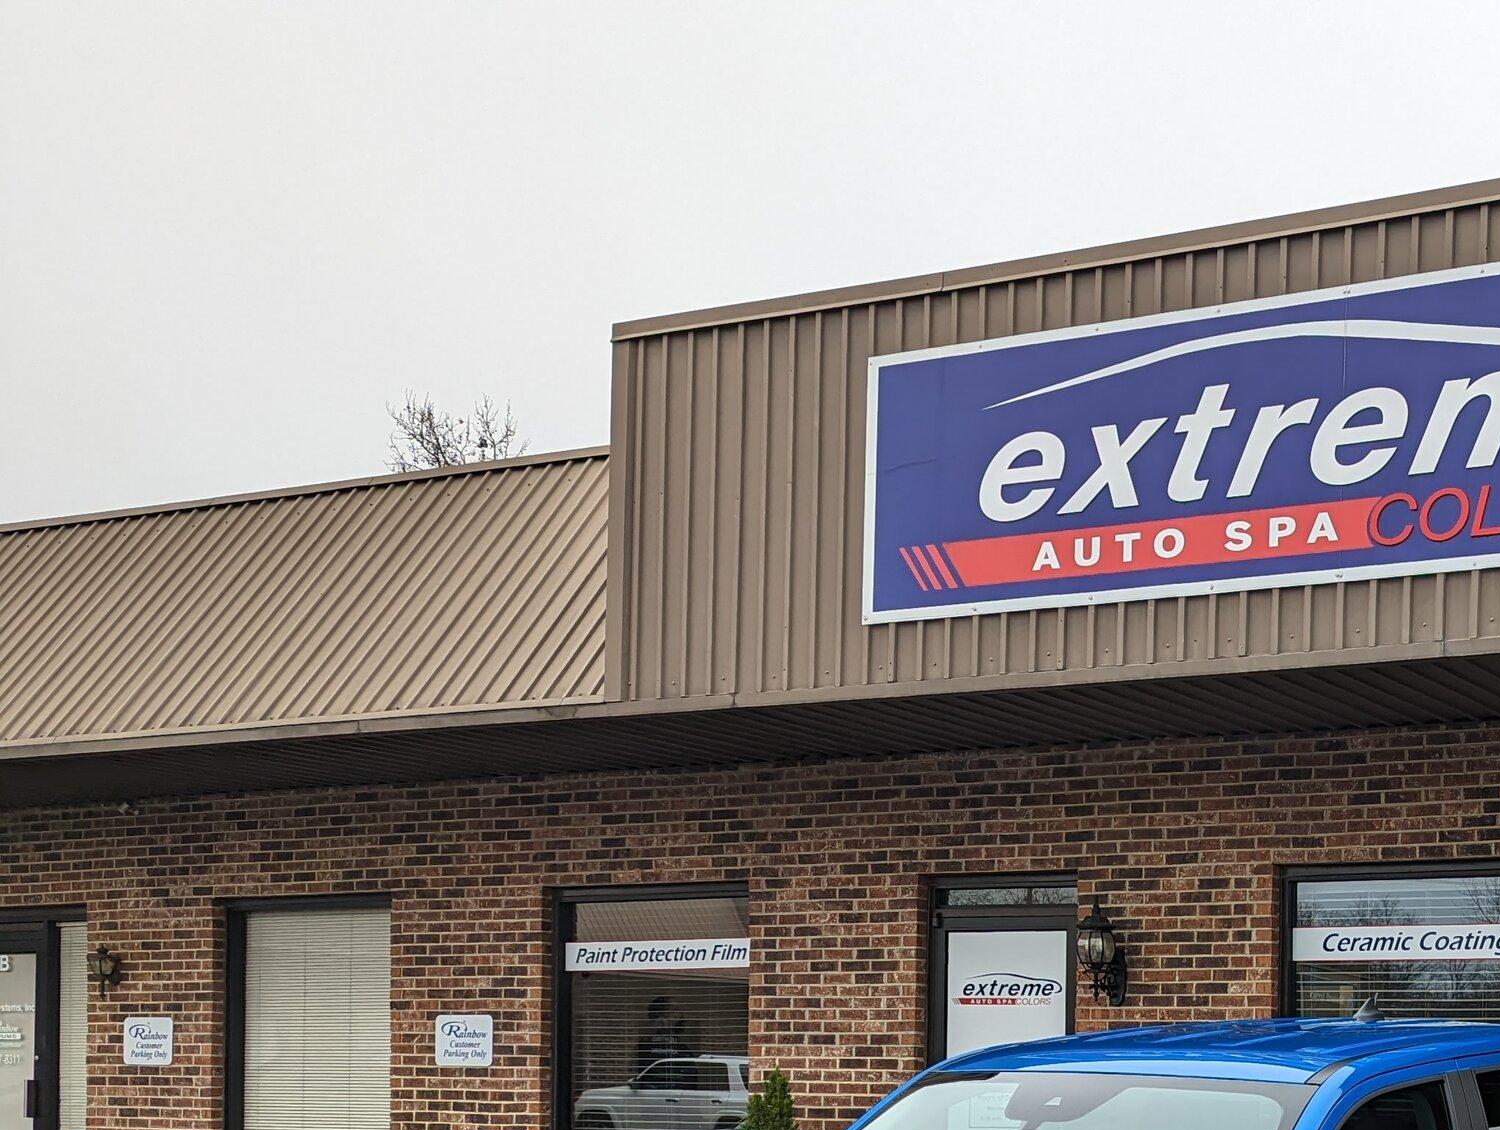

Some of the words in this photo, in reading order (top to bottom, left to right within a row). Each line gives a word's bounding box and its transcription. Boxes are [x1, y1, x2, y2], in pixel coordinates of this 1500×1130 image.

[1031, 528, 1185, 571] AUTO
[1223, 512, 1338, 552] SPA
[1322, 932, 1414, 952] Ceramic
[576, 948, 618, 964] Paint
[621, 945, 707, 963] Protection
[710, 944, 748, 961] Film
[962, 980, 1055, 996] extreme
[1016, 997, 1052, 1006] COLORS
[129, 1024, 168, 1040] Rainbow
[441, 1021, 487, 1039] Rainbow
[136, 1041, 162, 1049] Customer
[450, 1040, 481, 1049] Customer
[131, 1050, 152, 1059] Parking
[154, 1050, 167, 1060] Only
[443, 1049, 469, 1059] Parking
[471, 1050, 487, 1060] Only
